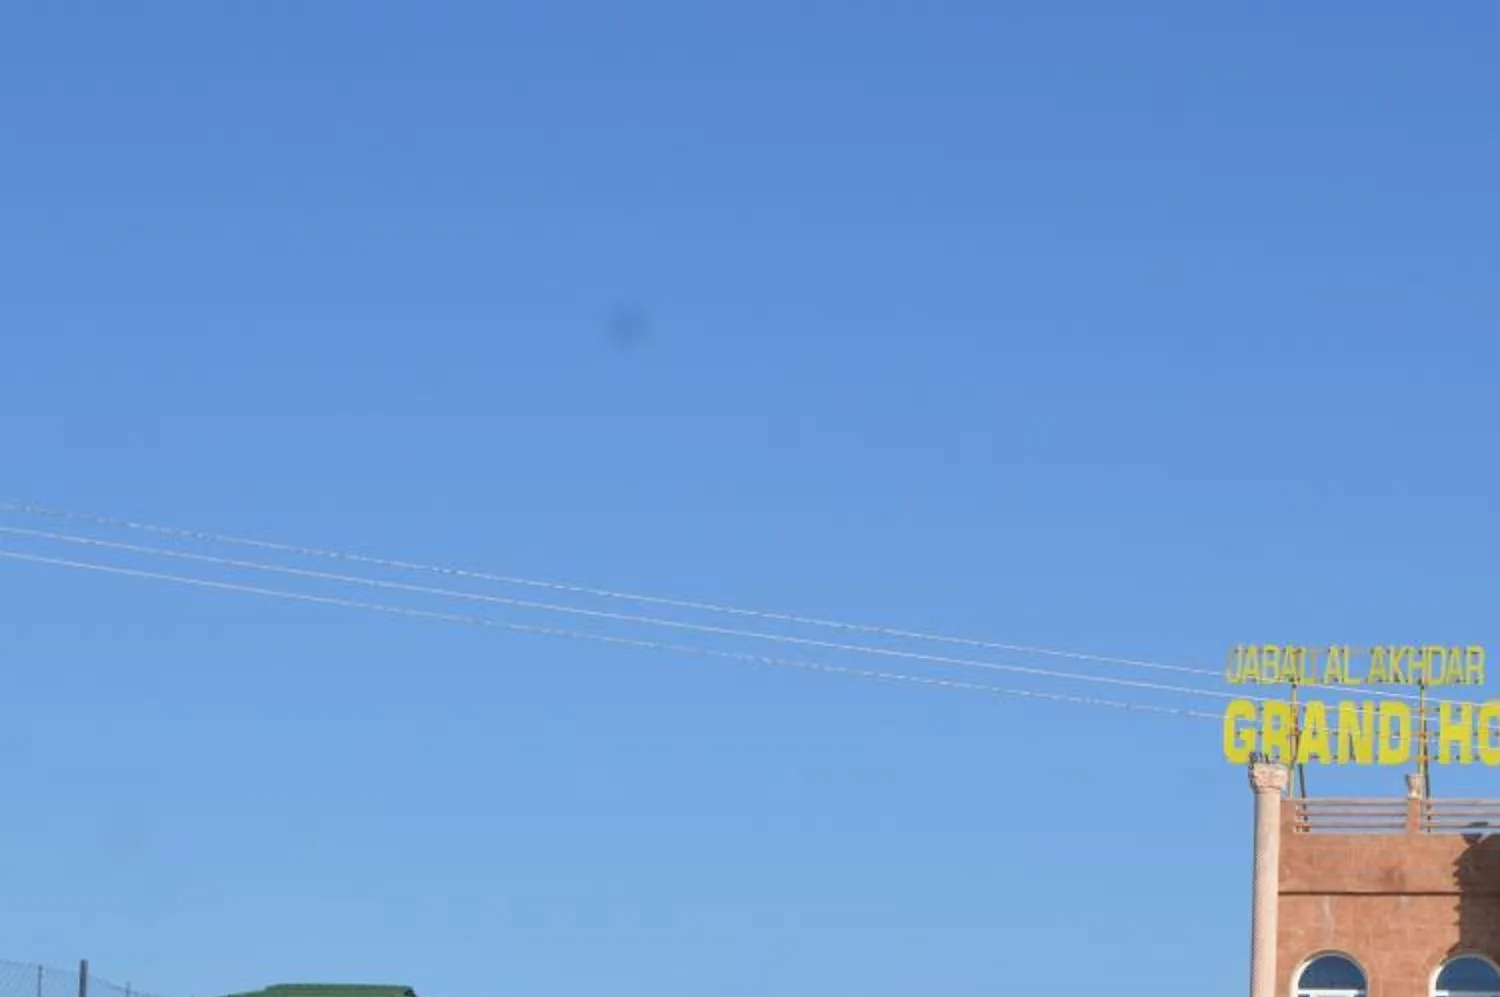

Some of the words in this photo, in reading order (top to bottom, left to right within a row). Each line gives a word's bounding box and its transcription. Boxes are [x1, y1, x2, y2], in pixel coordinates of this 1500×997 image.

[1226, 644, 1316, 685] JABAL
[1323, 644, 1361, 685] AL
[1368, 644, 1485, 685] AKHDAR
[1223, 699, 1412, 765] GRAND
